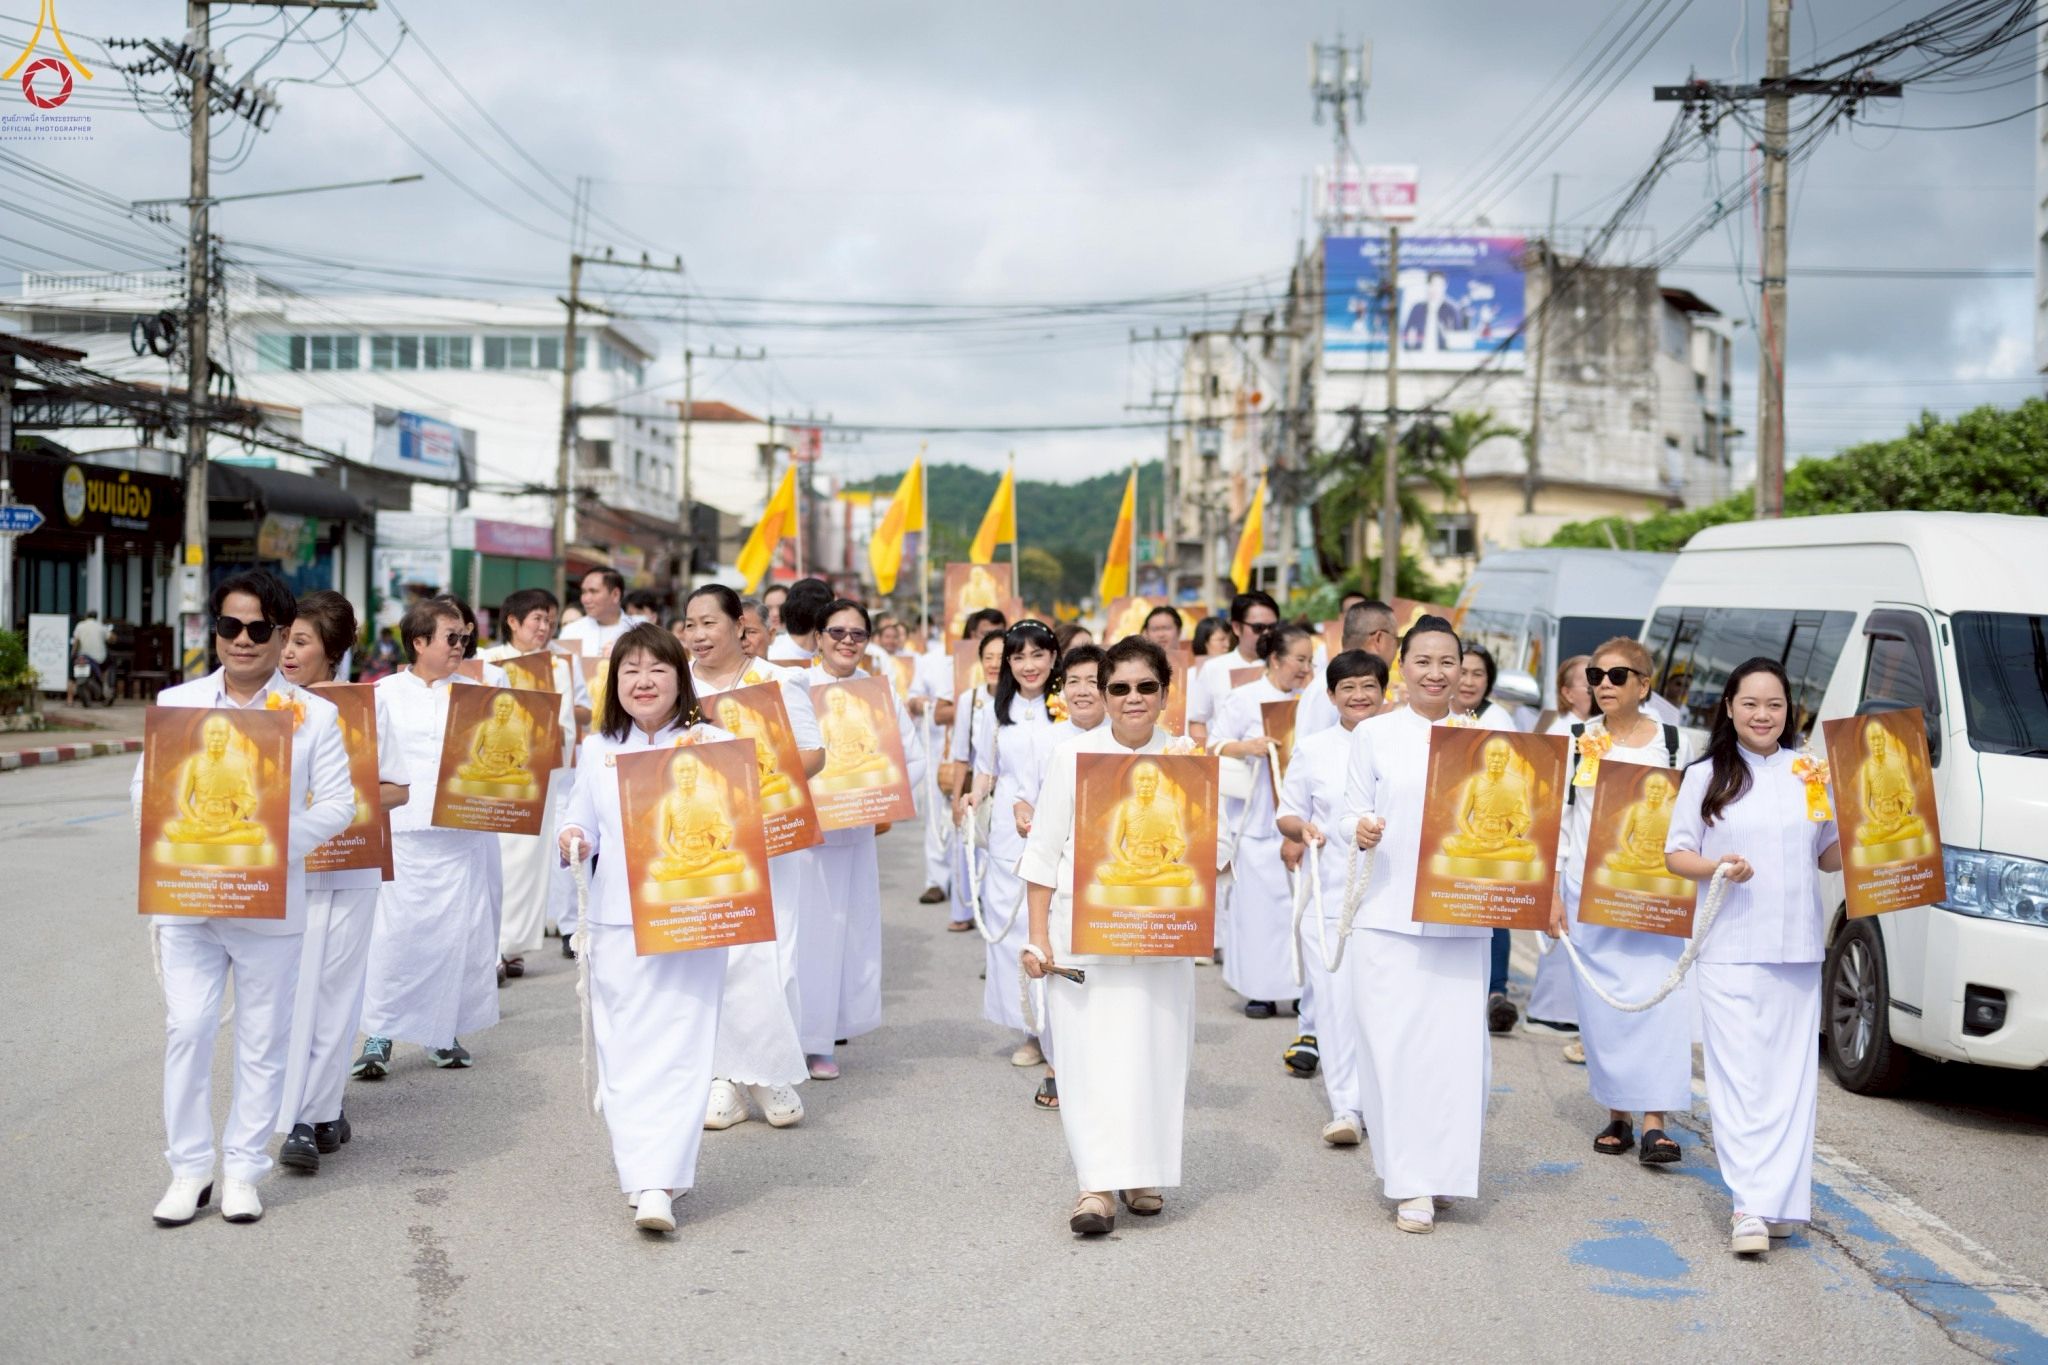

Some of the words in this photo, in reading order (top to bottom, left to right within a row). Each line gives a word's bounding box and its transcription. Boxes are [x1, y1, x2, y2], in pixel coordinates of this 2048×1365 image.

[87, 471, 151, 518] ชมเมือง
[1150, 922, 1164, 930] (สด
